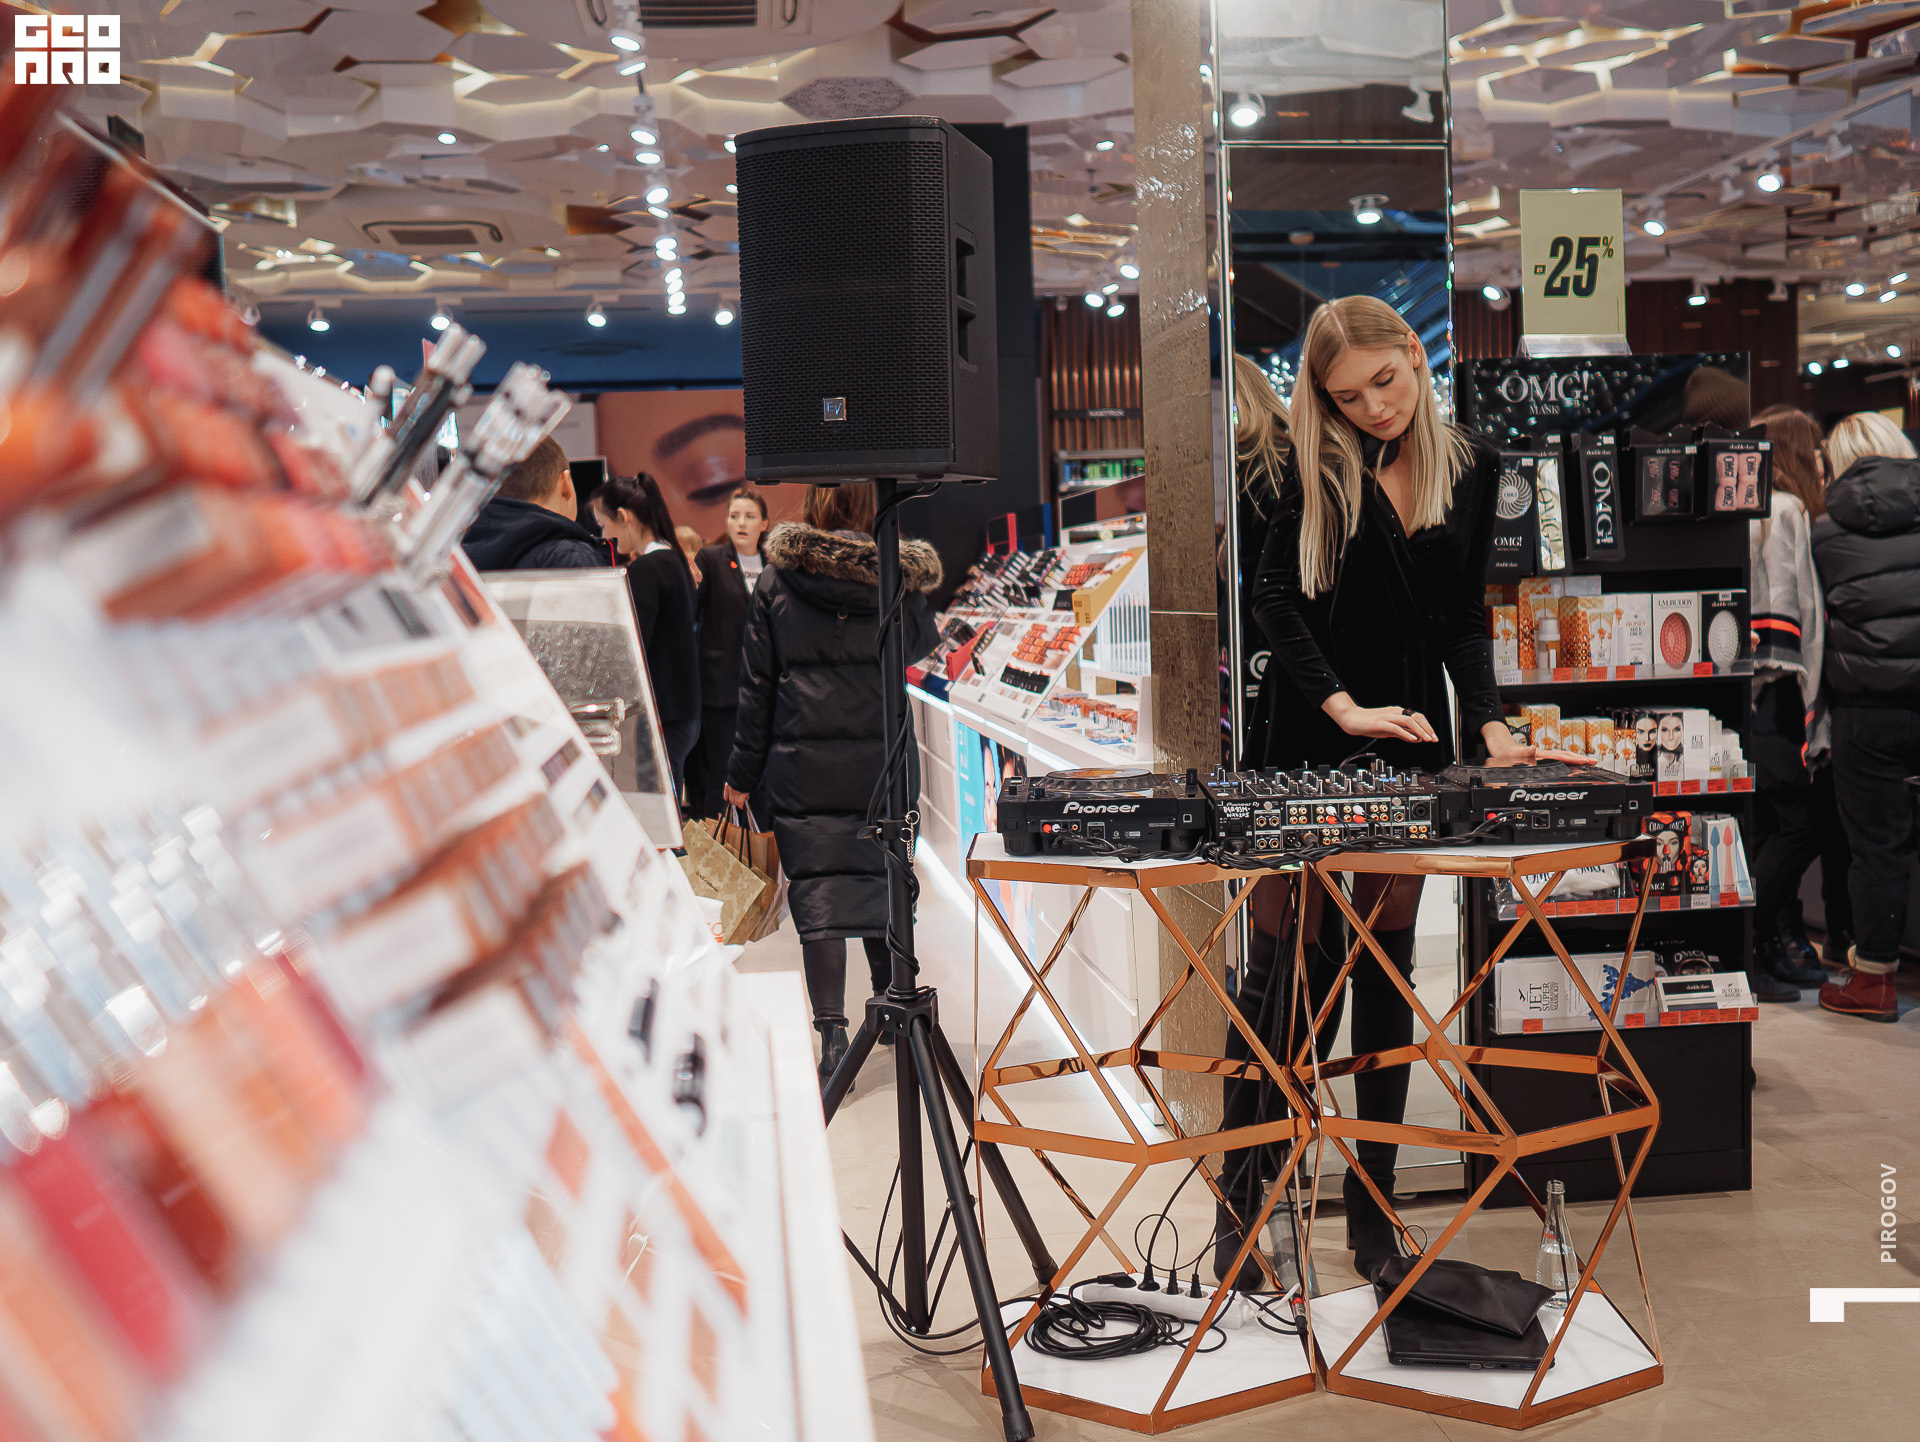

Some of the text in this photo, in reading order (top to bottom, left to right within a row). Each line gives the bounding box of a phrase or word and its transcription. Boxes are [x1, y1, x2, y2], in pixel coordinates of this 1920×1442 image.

[1534, 235, 1614, 297] -25%
[1501, 370, 1589, 403] OMG!
[1530, 403, 1560, 415] MASK
[1592, 461, 1615, 545] OMG!
[1494, 535, 1522, 547] OMG!
[1063, 801, 1140, 814] Pioneer
[1509, 789, 1588, 802] Pioneer
[1529, 983, 1542, 1012] JET
[1542, 982, 1550, 1012] SUPER
